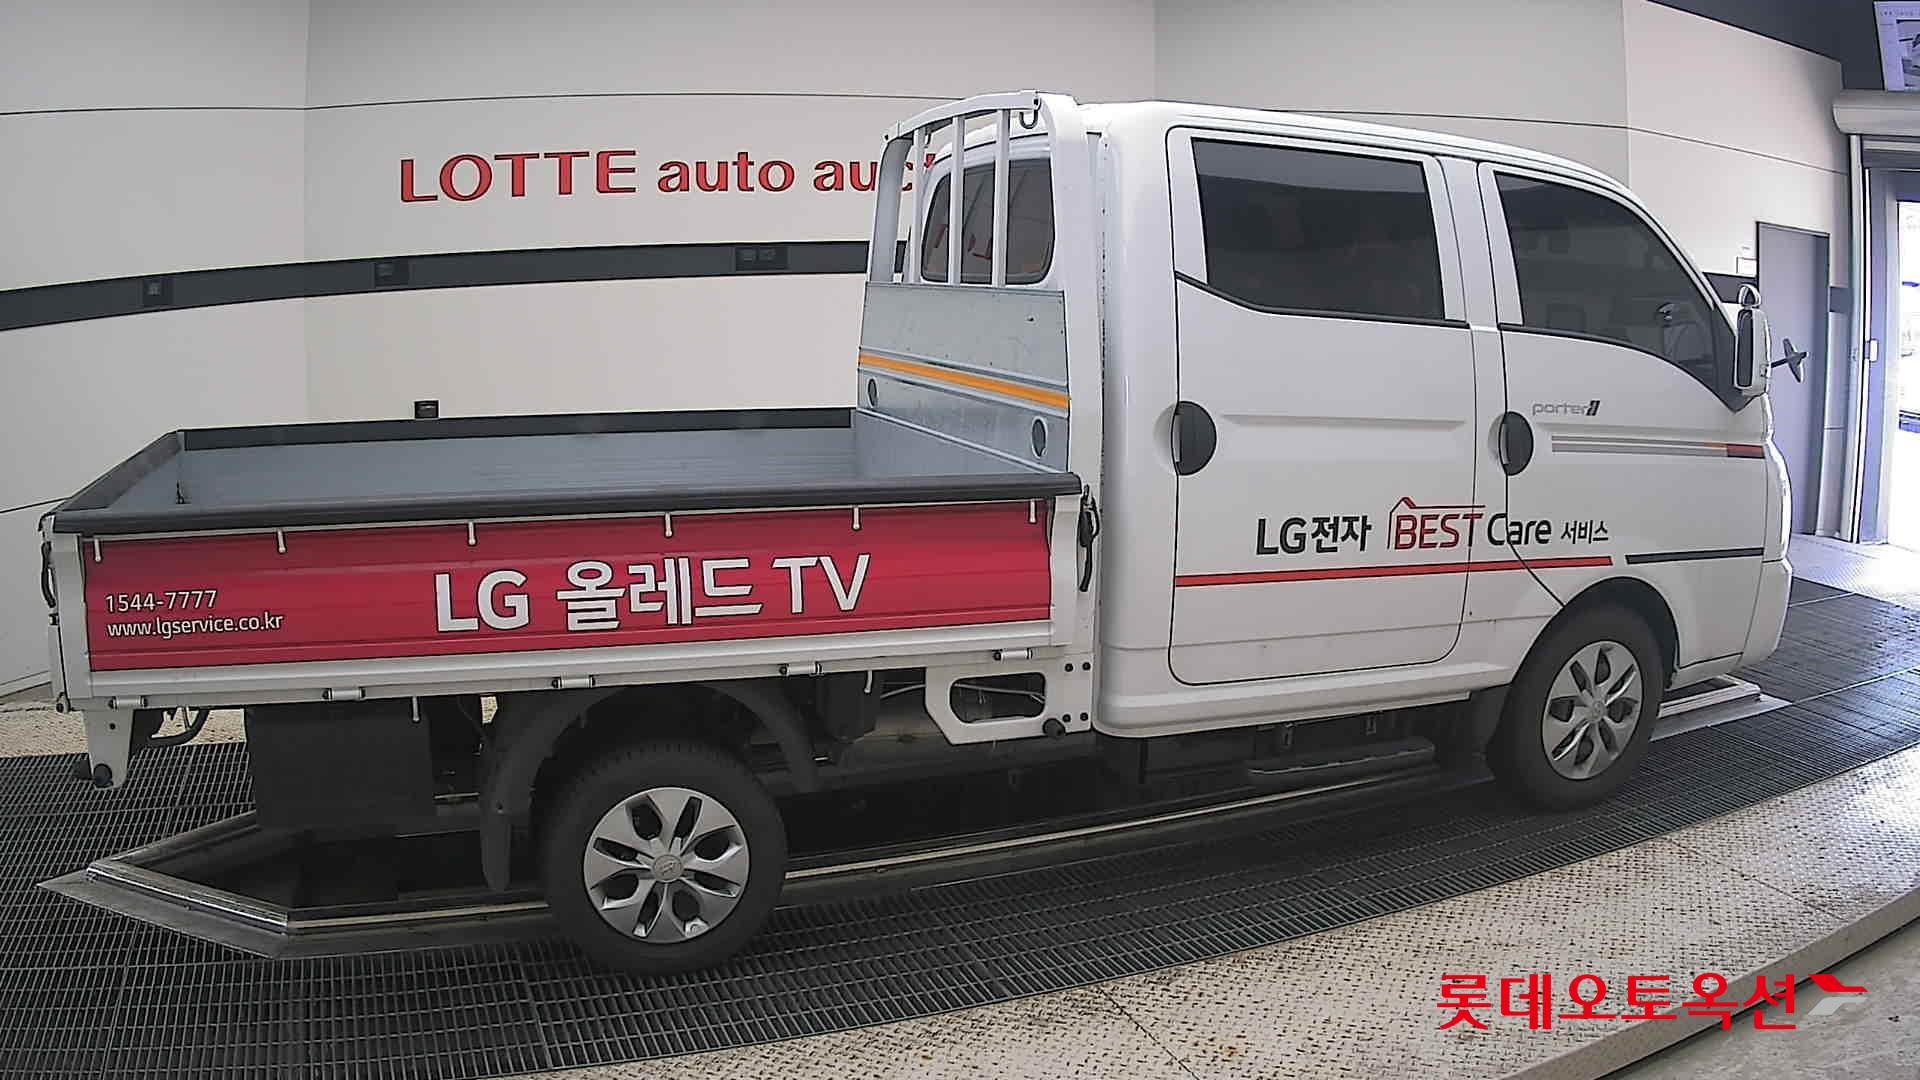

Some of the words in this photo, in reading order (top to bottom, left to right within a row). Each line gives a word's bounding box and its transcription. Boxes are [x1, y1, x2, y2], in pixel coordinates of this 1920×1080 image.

[399, 150, 637, 203] LOTTE
[657, 151, 796, 193] auto
[1256, 515, 1371, 555] LG전자
[1393, 513, 1484, 551] BEST
[1487, 513, 1552, 547] Care
[1560, 519, 1609, 545] 서비스
[105, 590, 217, 613] 1544-7777
[434, 569, 530, 633] LG
[556, 557, 763, 632] 올레드
[772, 554, 871, 615] TV
[107, 611, 284, 639] www.lgservice.co.kr
